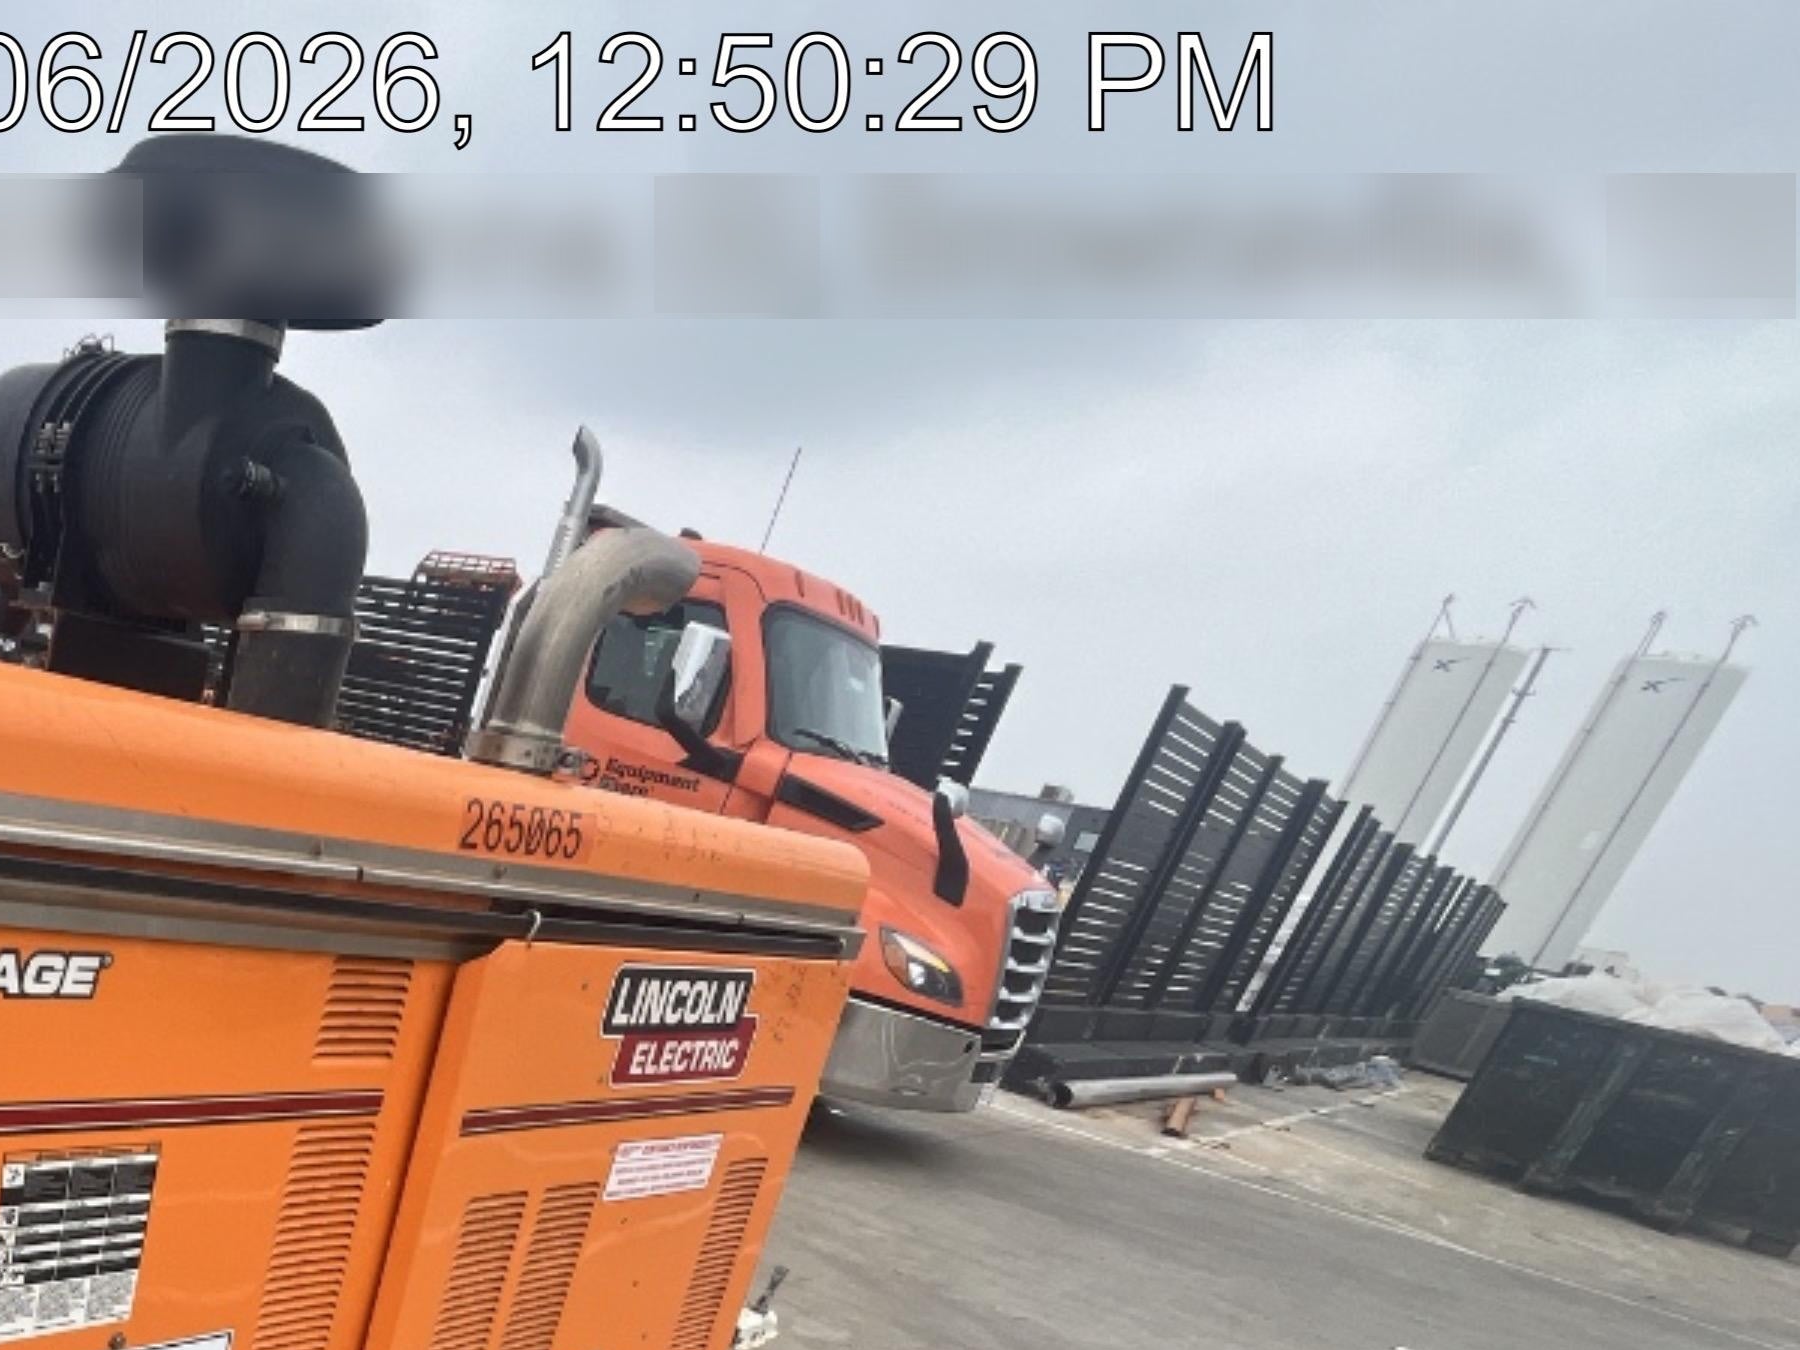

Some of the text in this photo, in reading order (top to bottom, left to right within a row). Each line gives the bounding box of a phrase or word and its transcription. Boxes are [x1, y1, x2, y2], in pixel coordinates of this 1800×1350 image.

[459, 797, 584, 859] 265065
[611, 977, 747, 1027] LINCOLN
[629, 1038, 740, 1076] ELECTRIC
